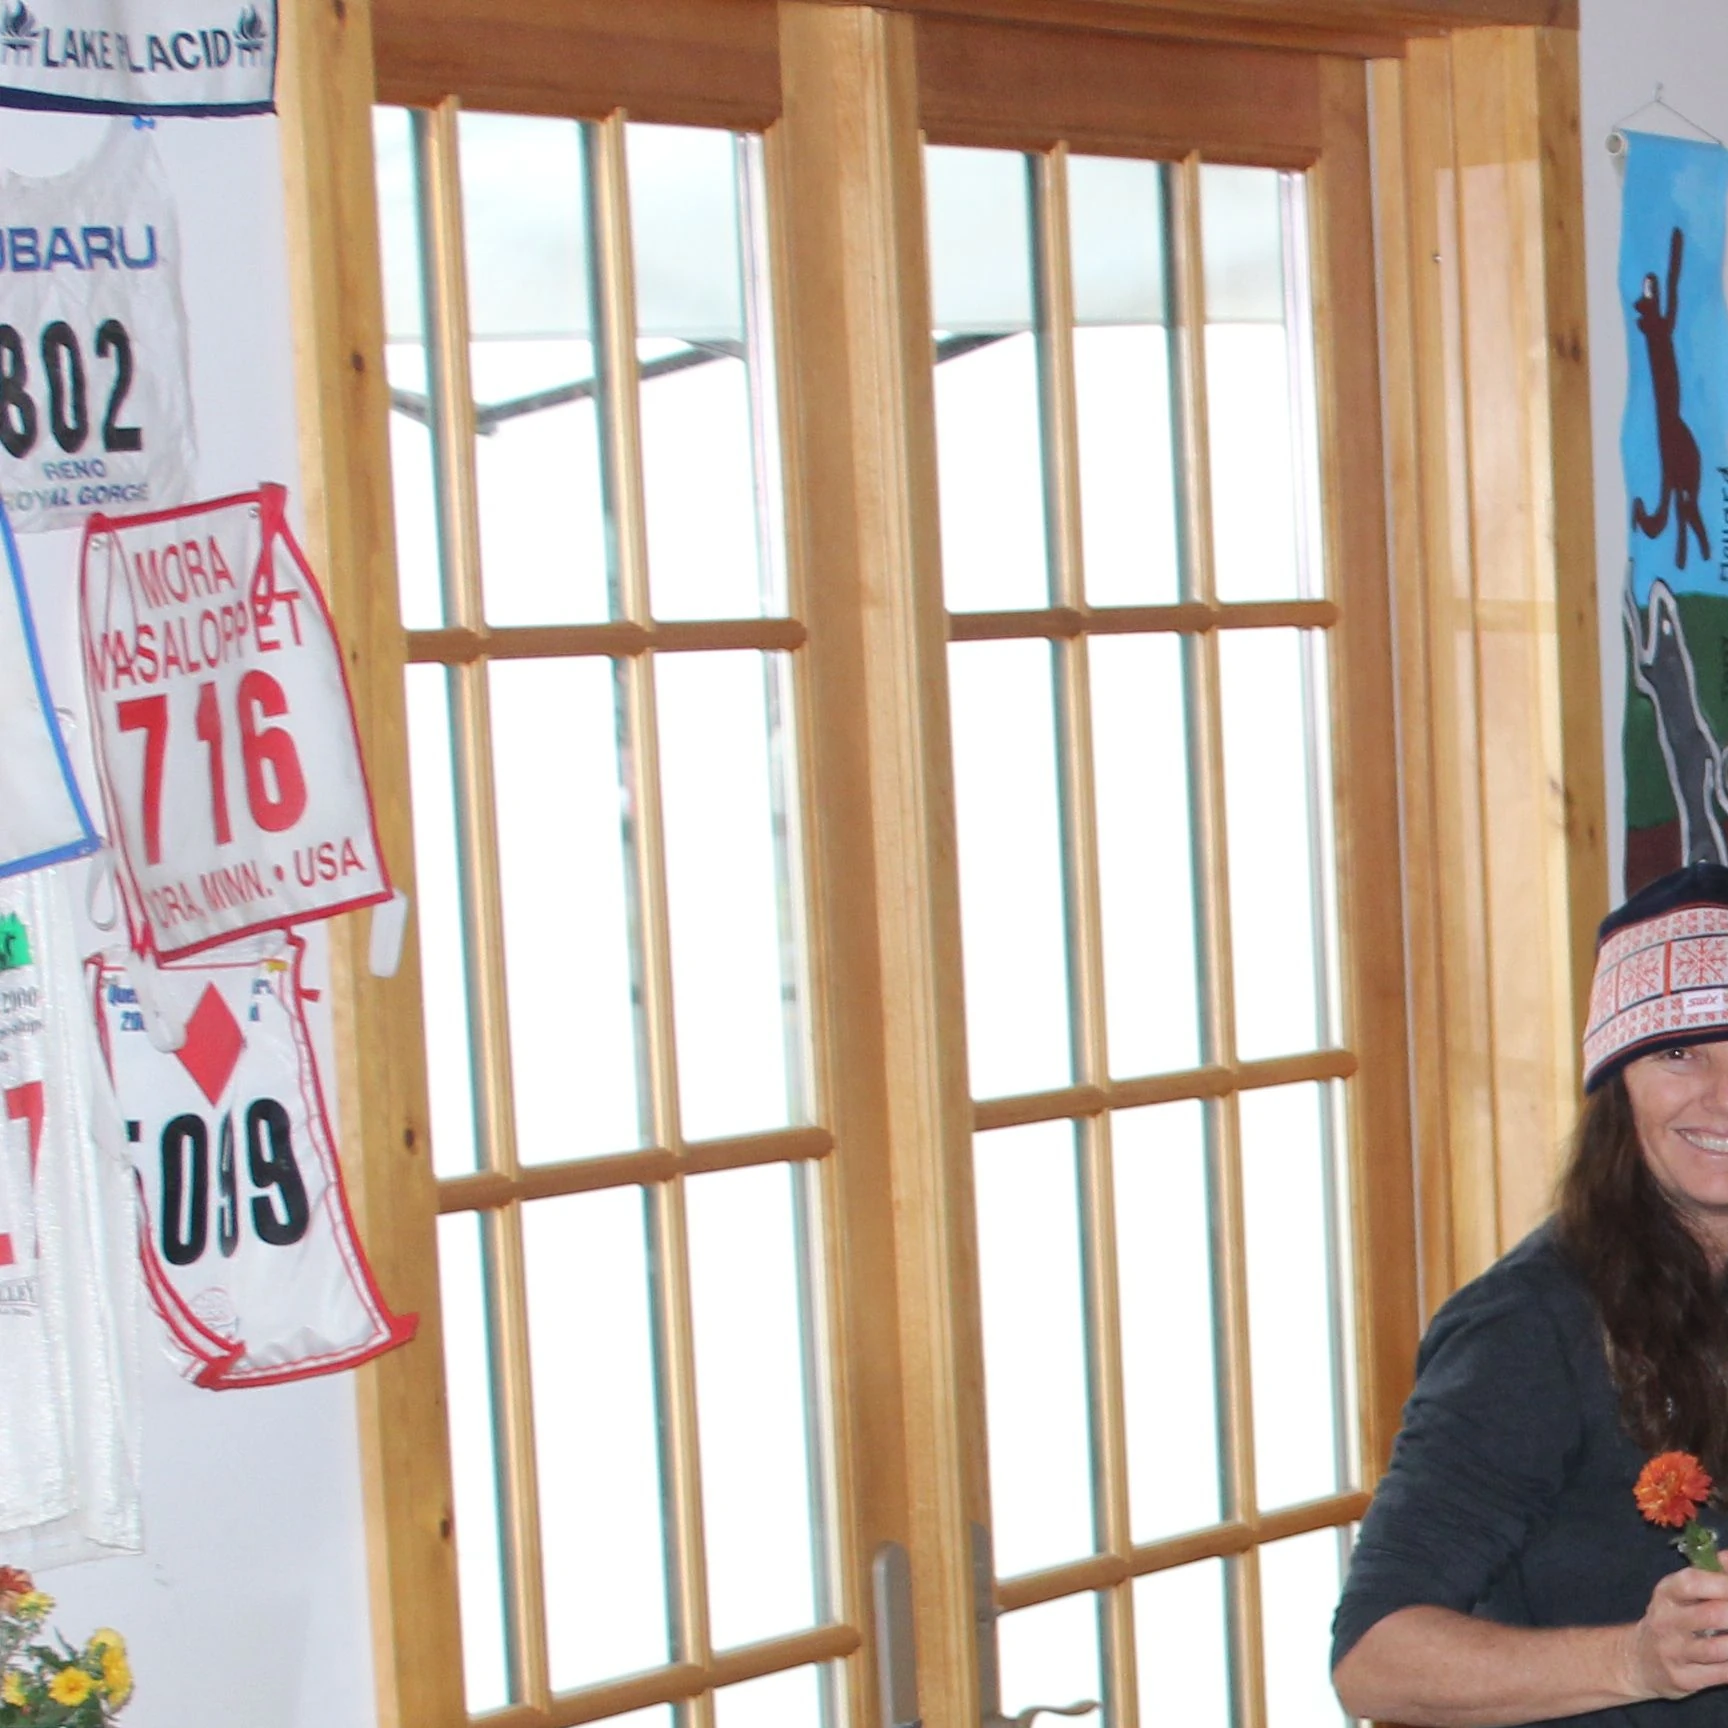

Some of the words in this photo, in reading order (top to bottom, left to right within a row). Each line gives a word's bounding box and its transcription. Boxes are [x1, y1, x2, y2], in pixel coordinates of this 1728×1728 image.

[42, 28, 114, 69] LAKE
[0, 225, 158, 272] BARU
[42, 459, 107, 481] RENO
[77, 482, 150, 505] GORGE
[134, 536, 236, 610] MORA
[116, 668, 308, 867] 716
[293, 837, 366, 888] USA
